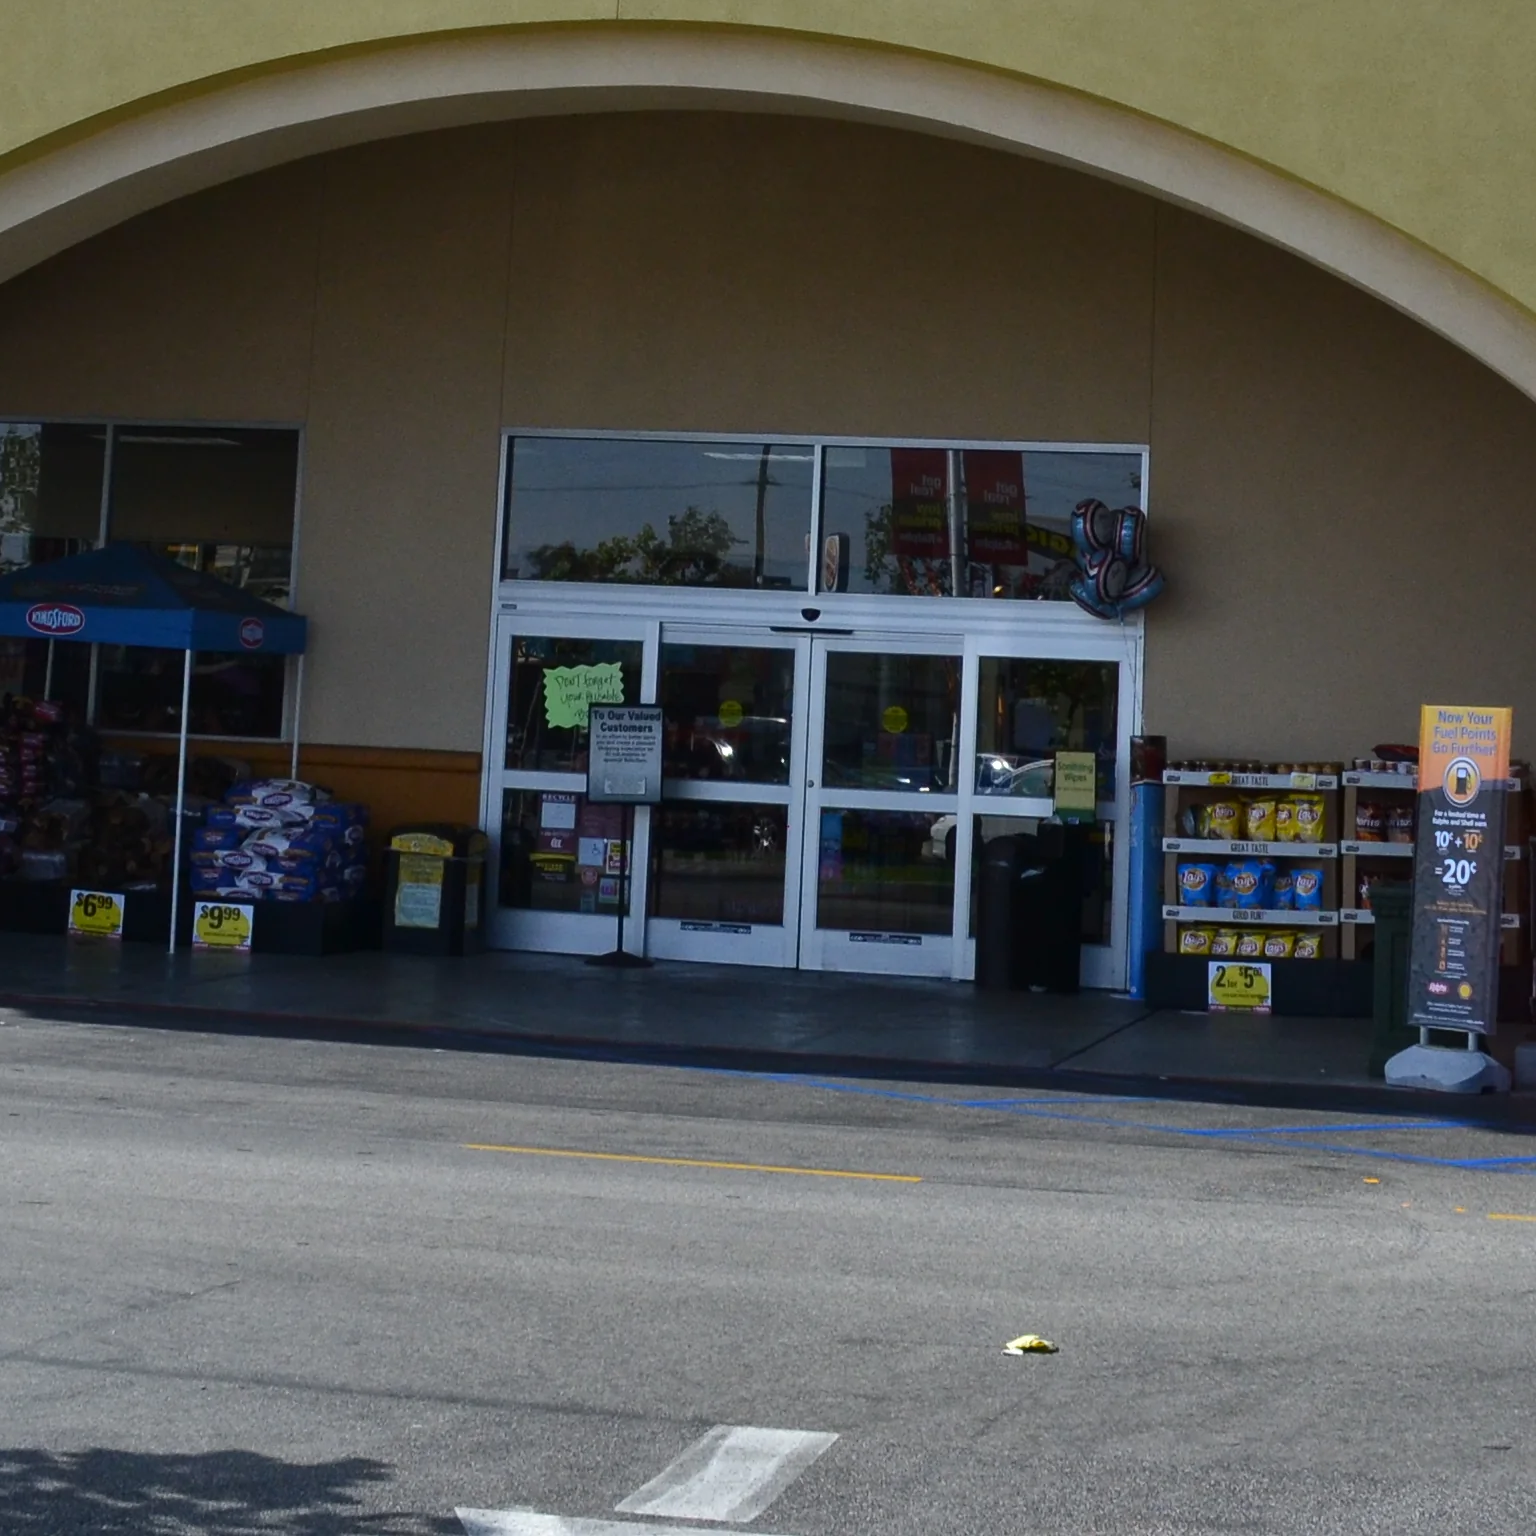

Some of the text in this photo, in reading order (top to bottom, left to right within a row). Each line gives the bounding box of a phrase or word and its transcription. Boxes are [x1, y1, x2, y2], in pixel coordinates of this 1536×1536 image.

[31, 608, 81, 629] KINGSFORD
[594, 710, 605, 720] To
[607, 711, 626, 720] Our
[627, 711, 661, 721] Valued
[1438, 710, 1494, 724] Now Your
[600, 722, 654, 733] Customers
[1434, 726, 1497, 741] Fuel Points
[1432, 741, 1497, 756] Go Further!
[1230, 843, 1269, 854] GREAT TASTE
[1232, 910, 1249, 920] GOOD
[1216, 965, 1226, 988] 2
